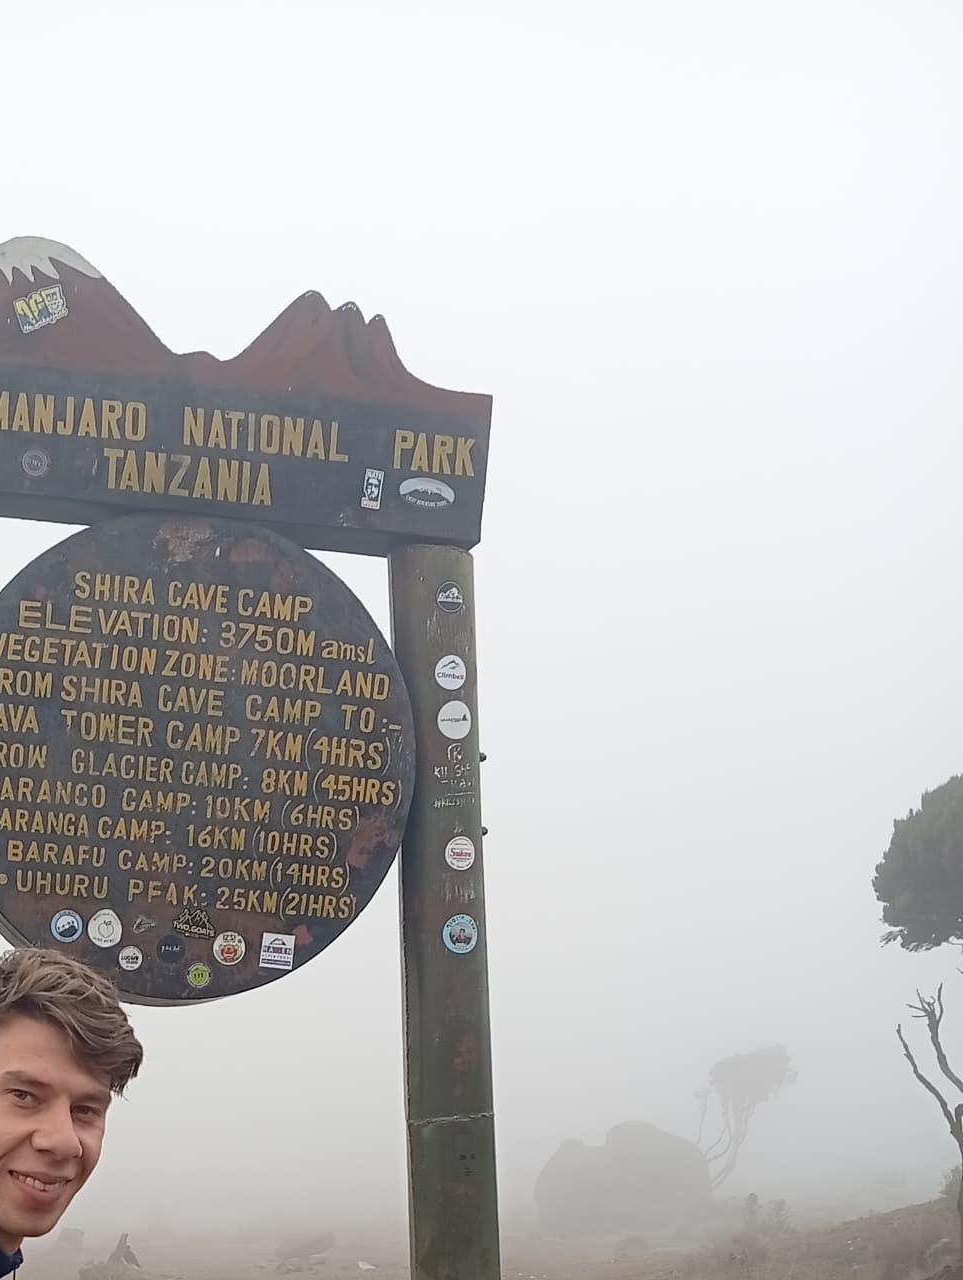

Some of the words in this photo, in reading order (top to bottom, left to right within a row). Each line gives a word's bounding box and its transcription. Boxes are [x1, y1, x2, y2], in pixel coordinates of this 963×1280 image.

[183, 406, 349, 462] NATIONAL
[393, 429, 476, 477] PARK
[103, 447, 272, 506] TANZANIA
[74, 571, 155, 606] SHIRA
[168, 581, 230, 613] CAVE
[238, 588, 313, 622] CAMP
[18, 599, 209, 645] ELEVATION:
[219, 620, 316, 657] 3750M
[321, 637, 376, 665] amsl
[162, 649, 236, 683] ZONE:
[240, 658, 391, 701] MOORLAND
[61, 675, 143, 709] SHIRA
[158, 684, 225, 717] CAVE
[245, 694, 322, 727] CAMP
[60, 708, 155, 748] TOWER
[166, 719, 242, 756] CAMP
[71, 748, 175, 784] GLACIER
[181, 761, 250, 790] CAMP:
[261, 767, 308, 797] 8KM
[97, 816, 172, 845] CAMP:
[186, 824, 246, 851] 16KM
[121, 787, 198, 815] CAMP:
[204, 794, 272, 824] 10KM
[280, 799, 361, 831] (6HRS)
[7, 839, 107, 868] BARAFU
[117, 849, 194, 875] CAMP:
[15, 869, 109, 899] UHURU
